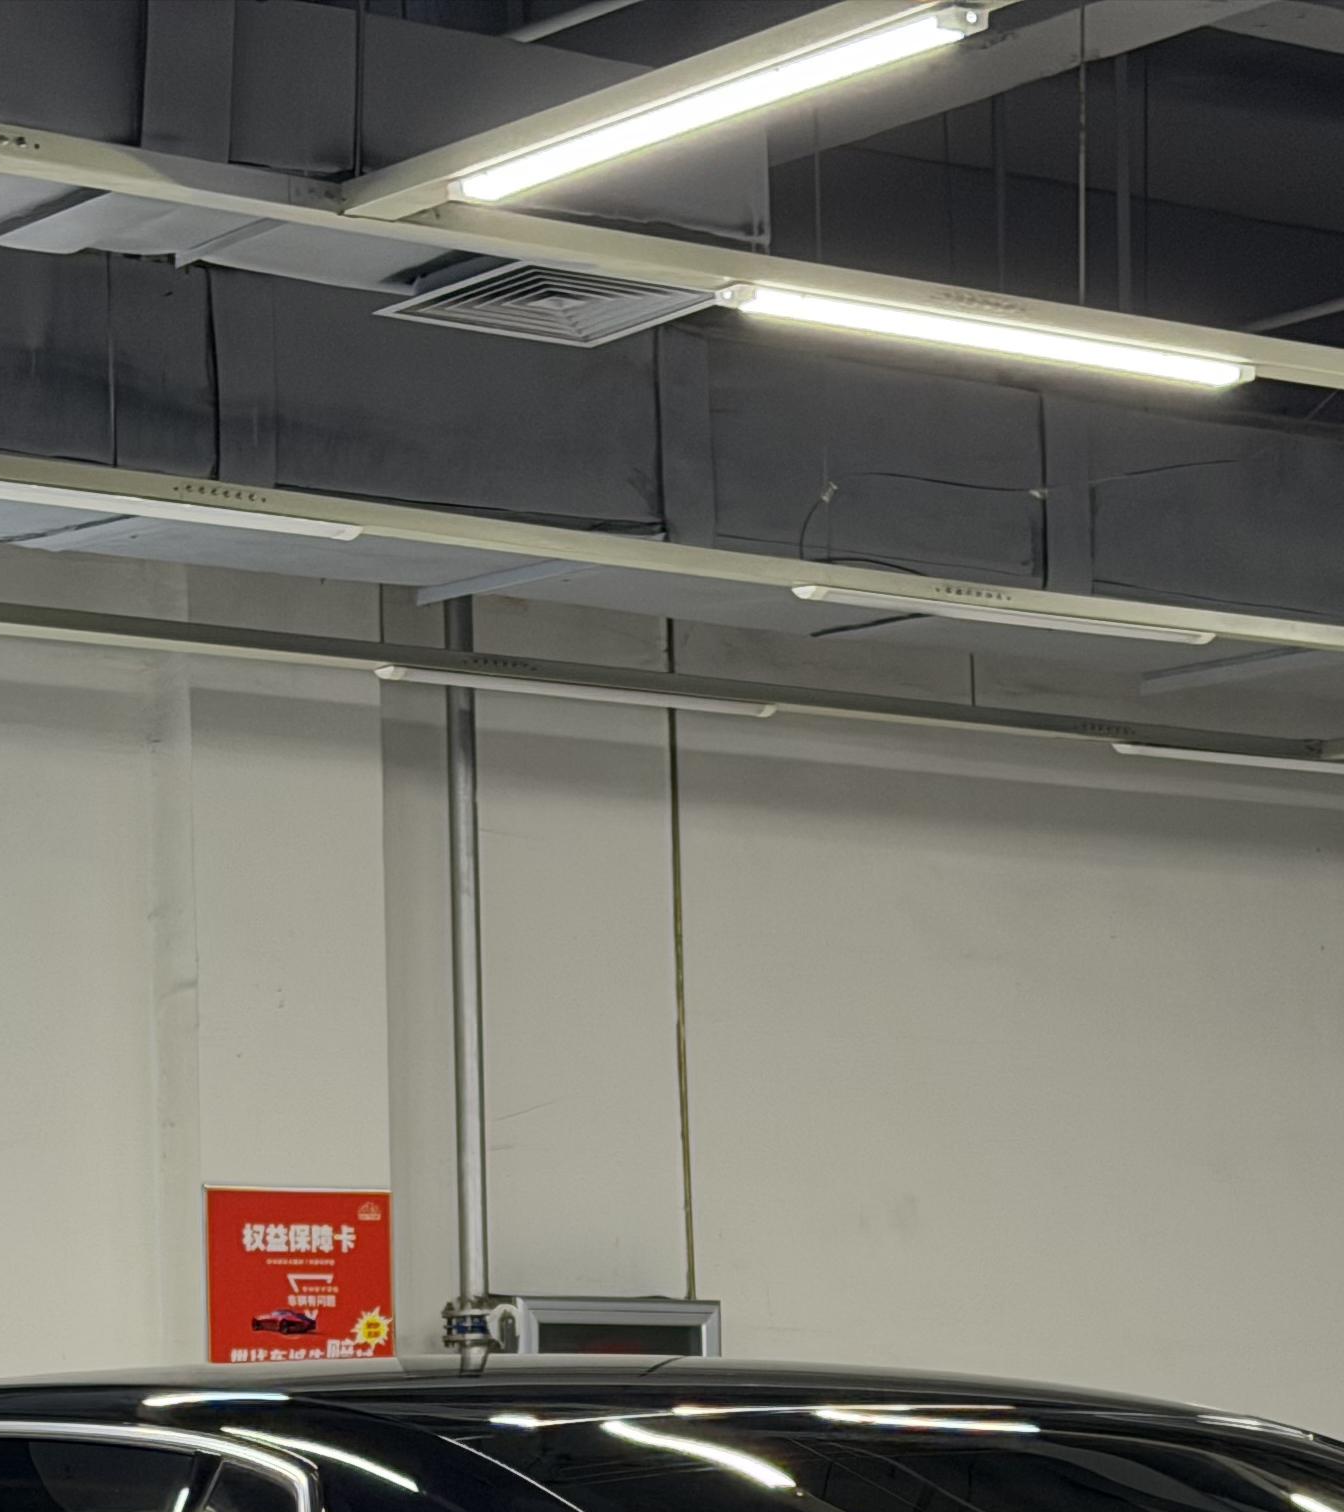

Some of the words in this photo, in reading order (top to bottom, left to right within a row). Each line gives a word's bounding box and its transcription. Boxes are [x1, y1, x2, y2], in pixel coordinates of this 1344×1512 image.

[242, 1223, 357, 1253] 权益保障卡
